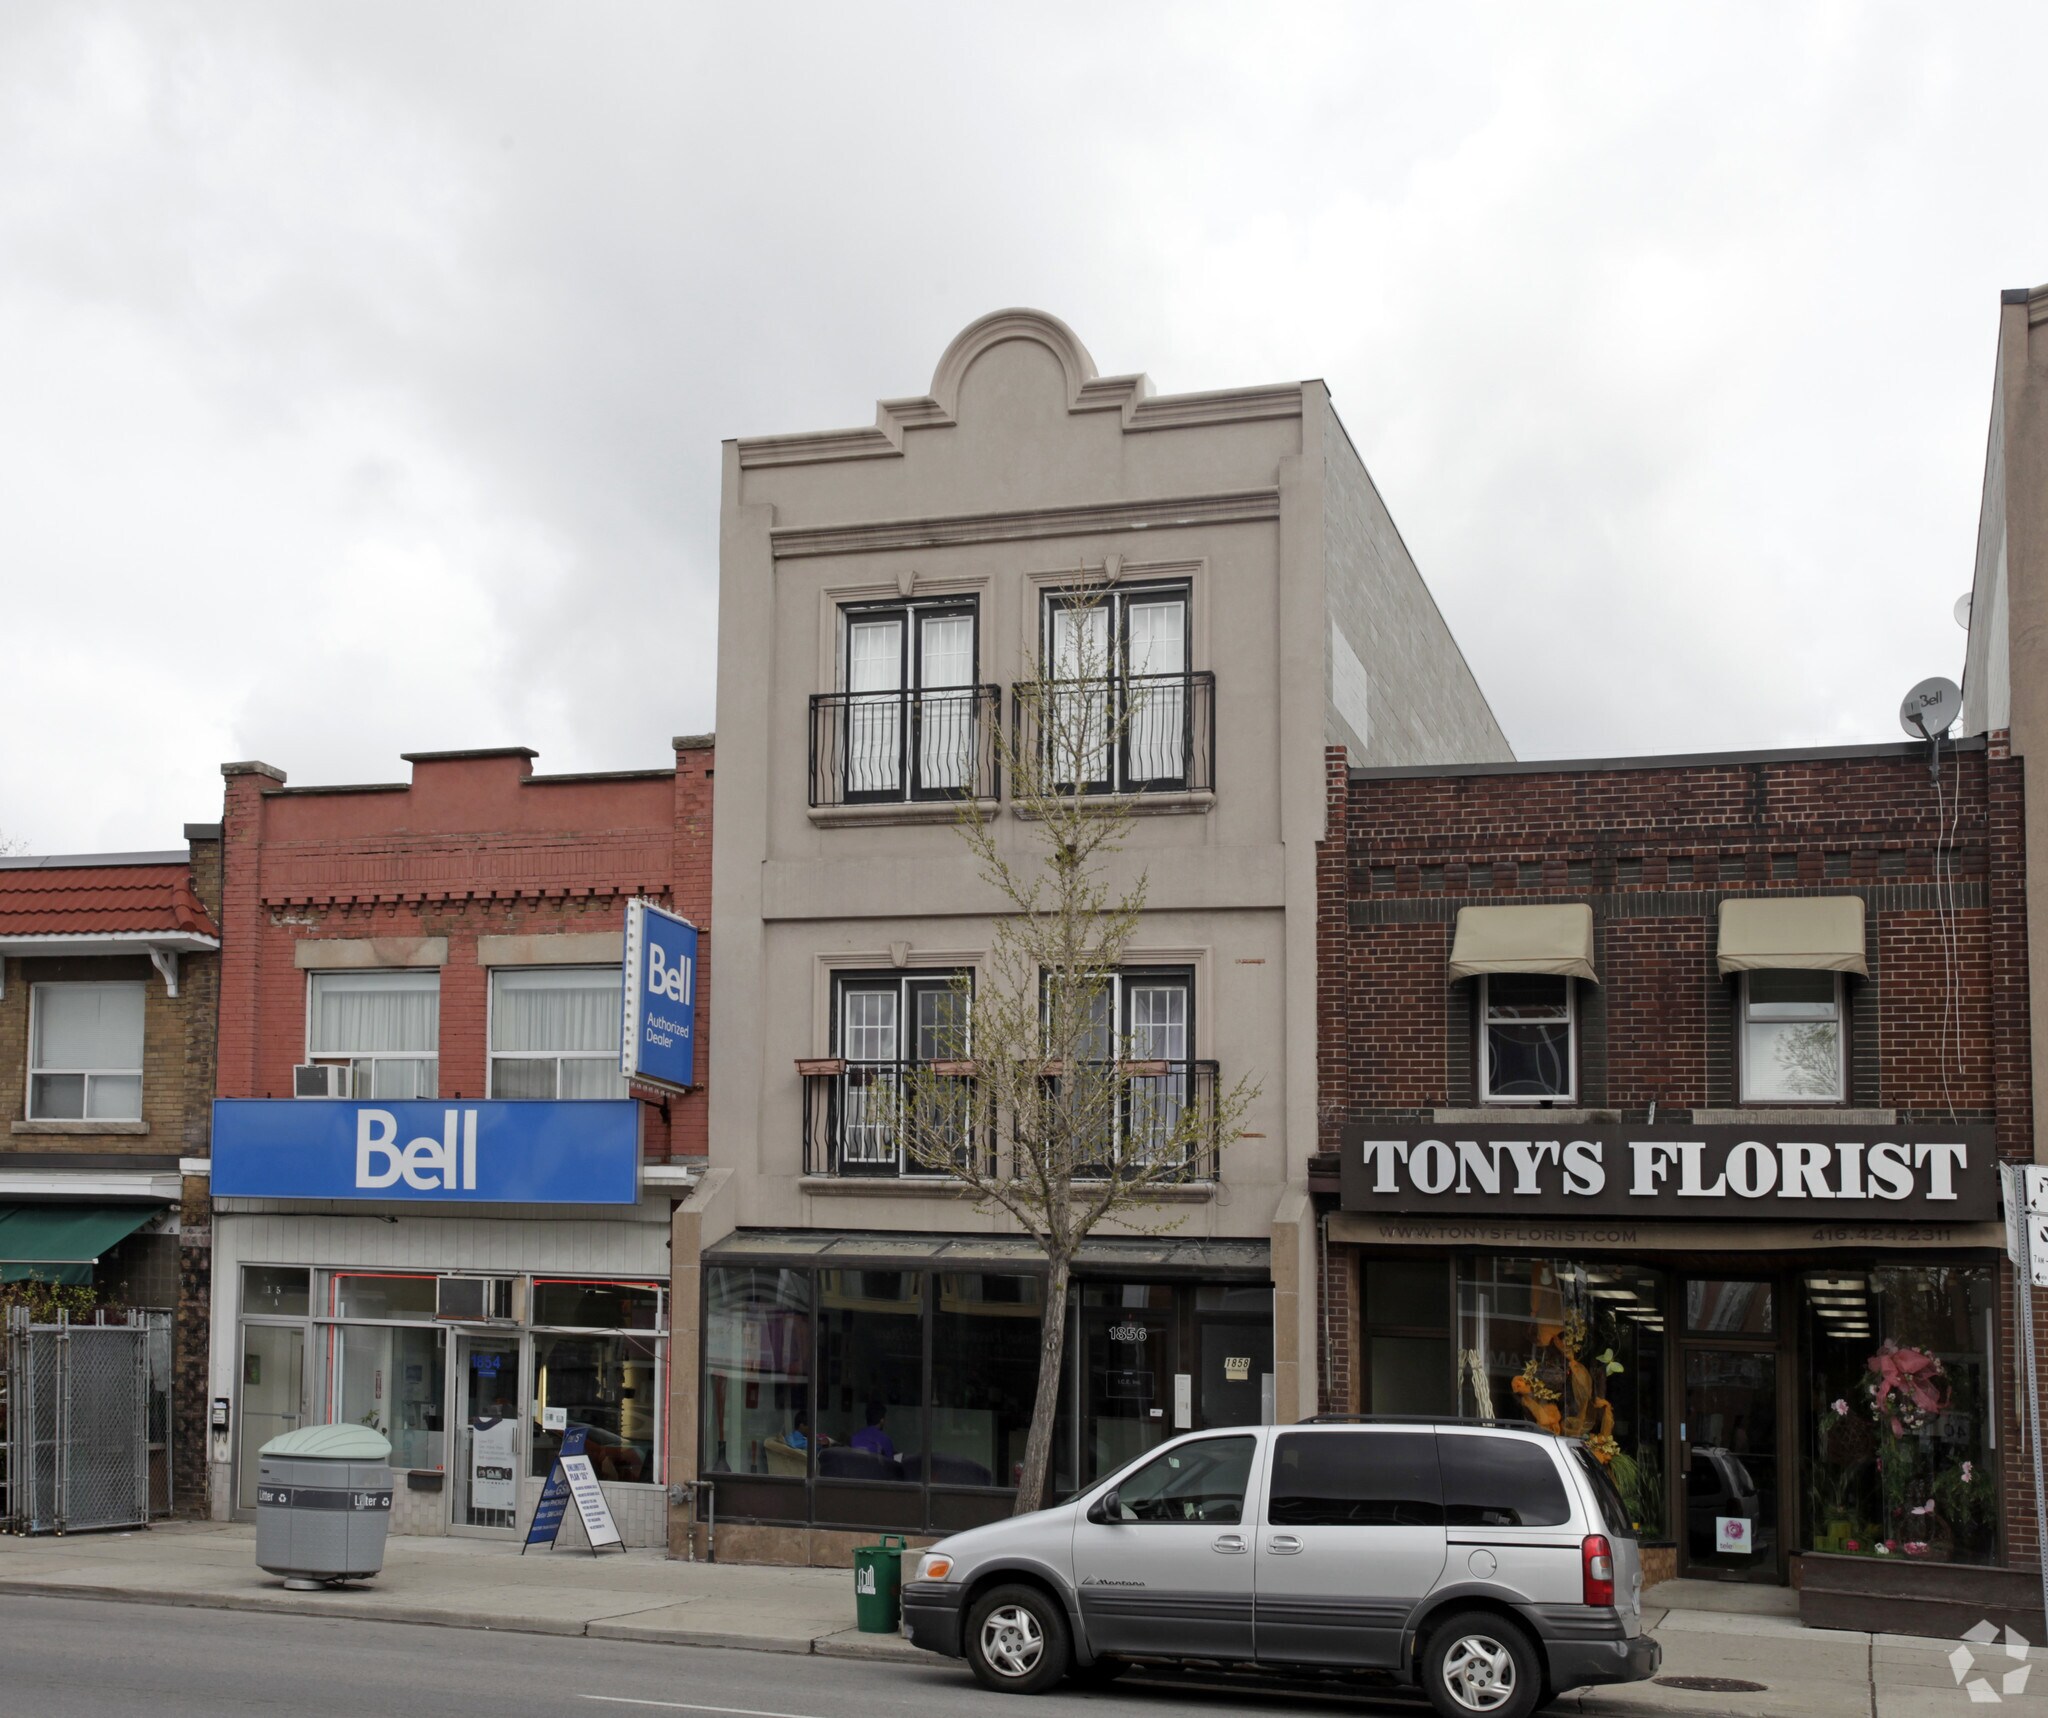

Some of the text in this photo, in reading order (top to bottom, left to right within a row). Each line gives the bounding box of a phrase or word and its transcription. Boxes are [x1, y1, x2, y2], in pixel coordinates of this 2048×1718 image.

[648, 942, 691, 1006] Bell
[647, 1012, 689, 1039] Authorized
[646, 1028, 673, 1049] Dealer
[355, 1108, 478, 1190] Bell
[1363, 1139, 1968, 1201] TONY'S FLORIST
[1378, 1226, 1638, 1243] WWW.TONYSFLORIST.COM
[1812, 1228, 1951, 1242] 416.424.2311
[1108, 1326, 1147, 1341] 1856
[471, 1354, 501, 1369] 1854
[1226, 1358, 1249, 1368] 1858
[259, 1489, 275, 1502] Litter
[1096, 1579, 1145, 1587] Montana
